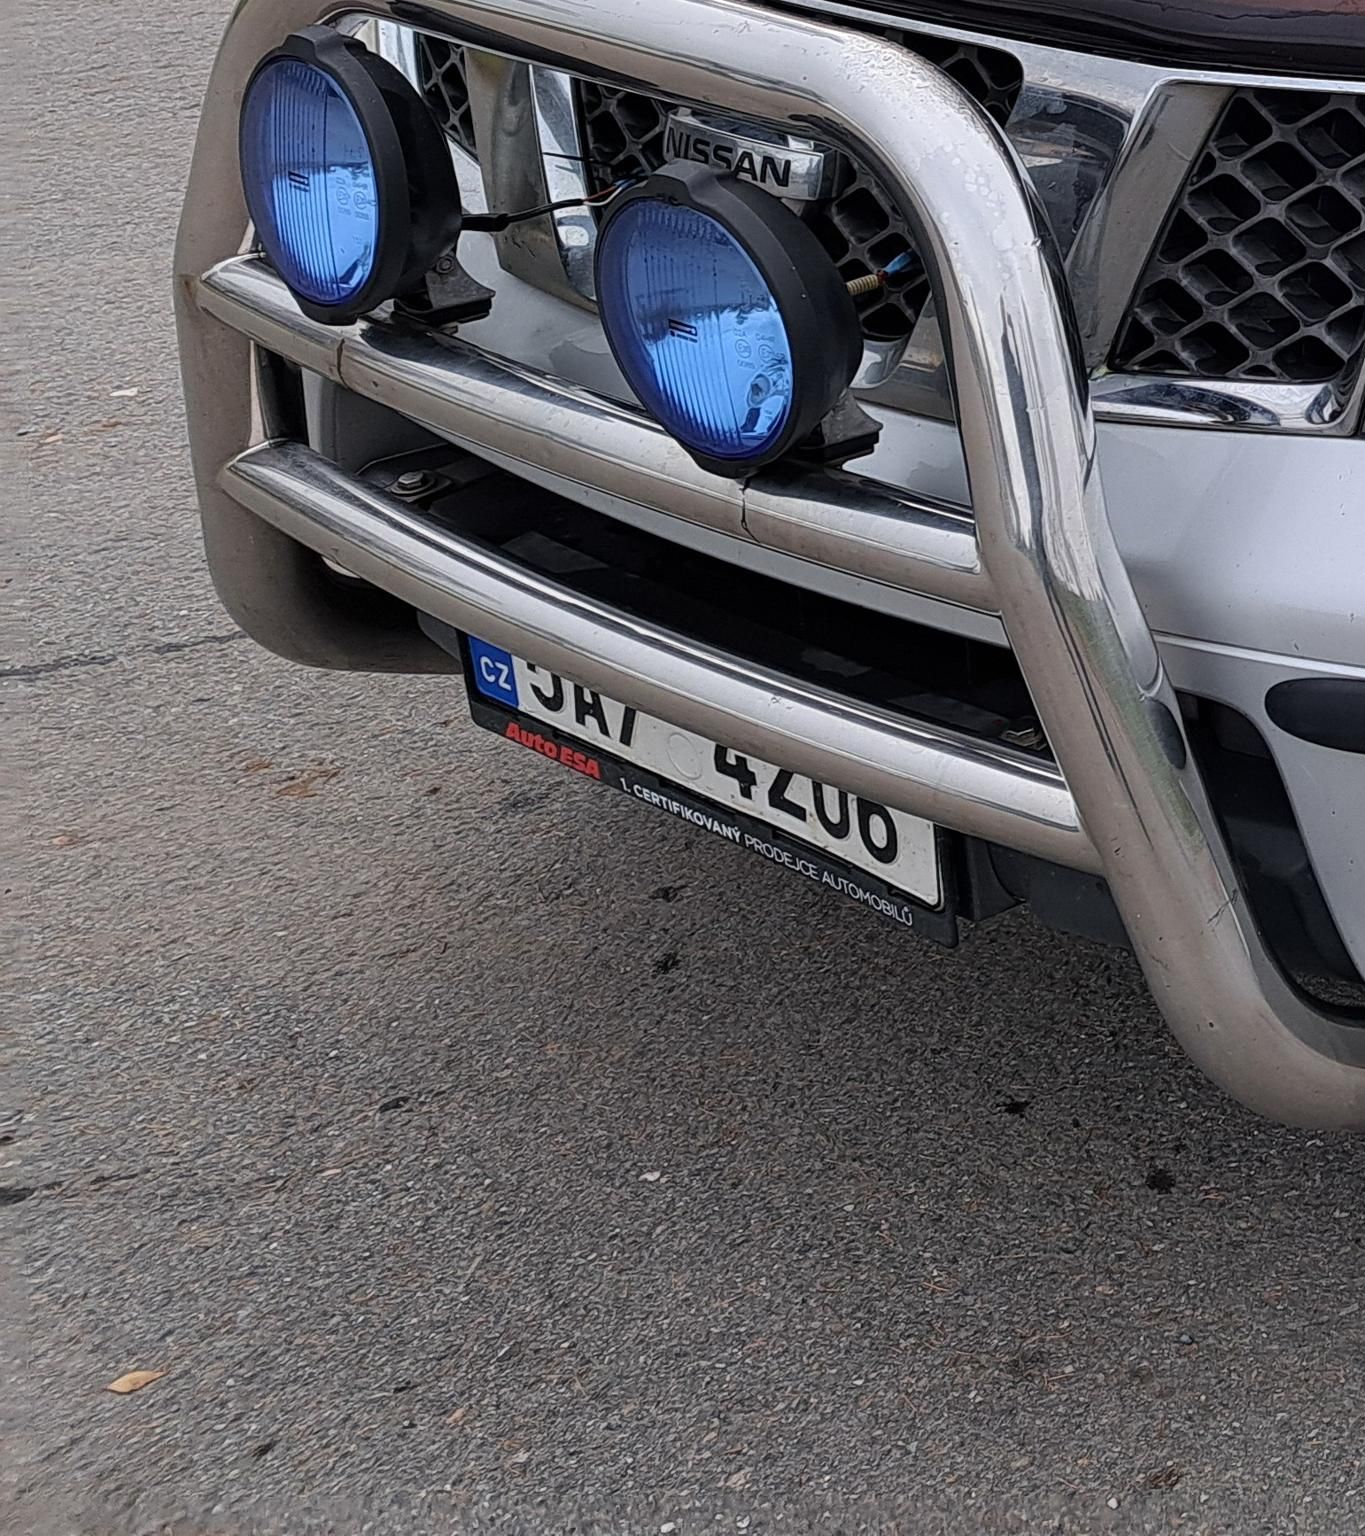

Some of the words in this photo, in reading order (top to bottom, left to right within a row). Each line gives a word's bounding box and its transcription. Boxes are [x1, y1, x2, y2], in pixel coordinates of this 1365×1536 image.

[665, 126, 792, 188] NISSAN
[479, 655, 513, 692] CZ
[505, 721, 558, 759] Auto
[559, 746, 602, 780] ESA
[619, 777, 632, 794] 1.
[632, 783, 742, 845] CERTIFIKOVANÝ
[744, 833, 821, 882] PRODEJCE
[821, 870, 913, 927] AUTOMOBILŮ
